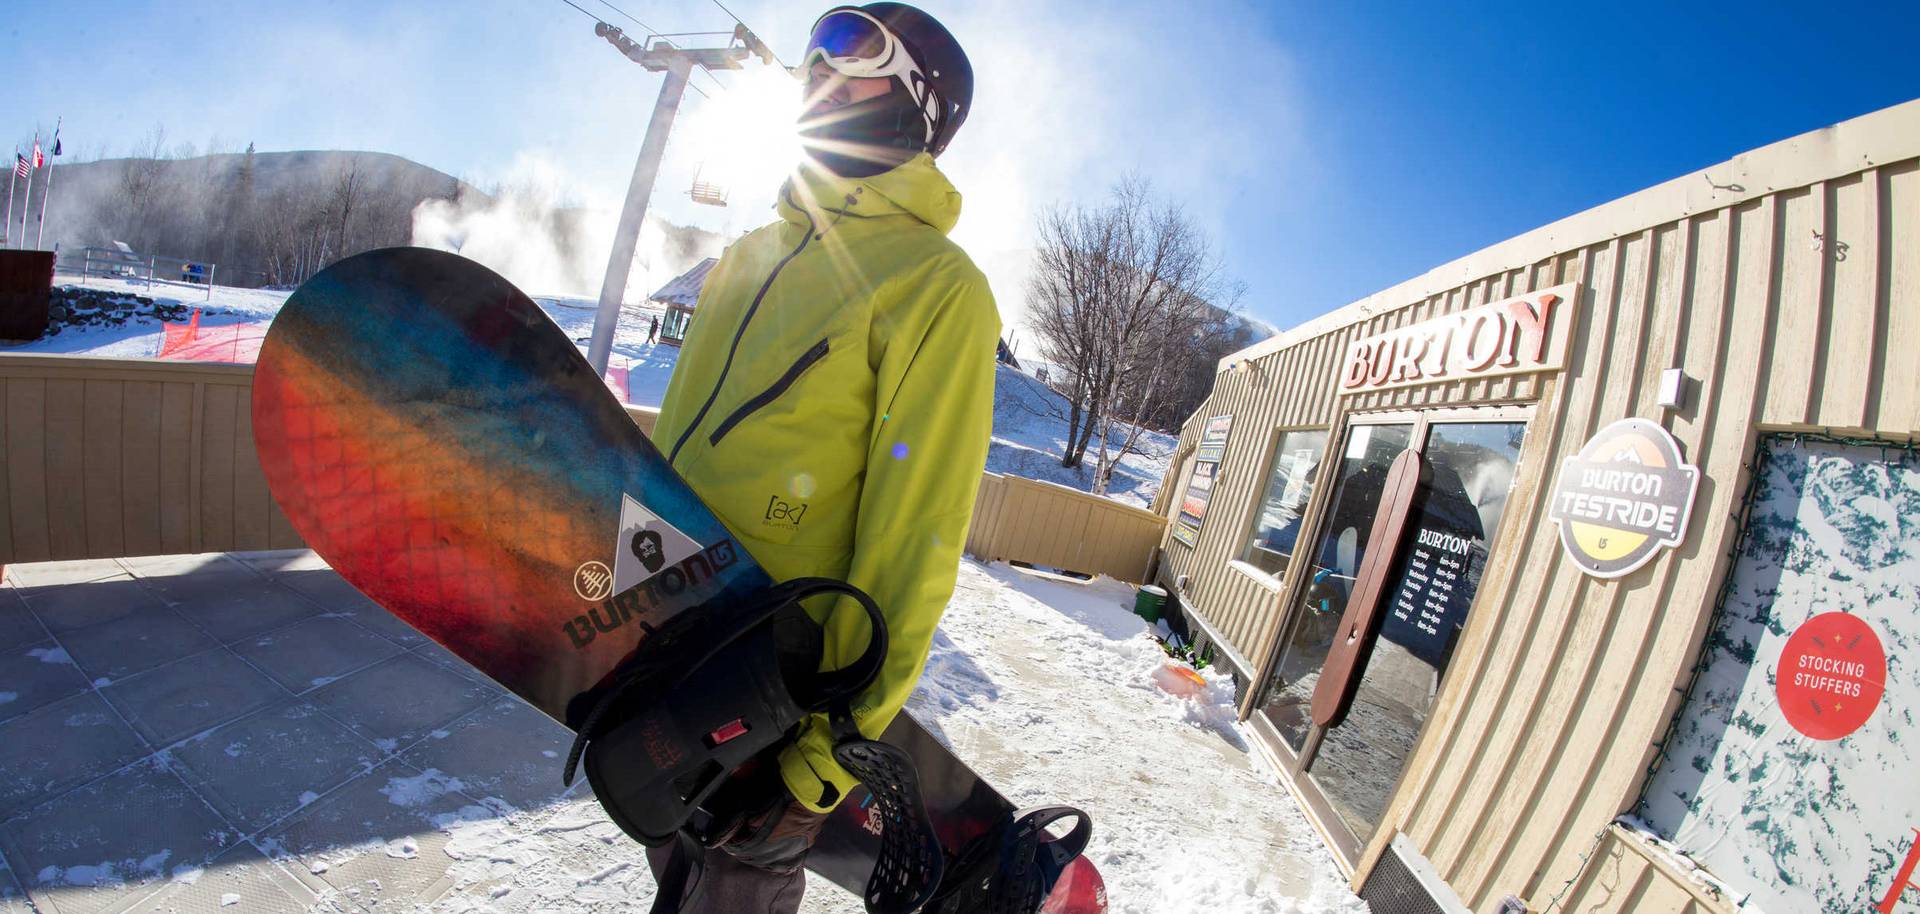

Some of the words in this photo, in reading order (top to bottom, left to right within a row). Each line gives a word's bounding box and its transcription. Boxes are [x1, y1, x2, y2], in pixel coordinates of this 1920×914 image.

[1343, 294, 1560, 388] BURTON
[1581, 468, 1662, 497] BURTON
[1561, 491, 1679, 533] TESTRIDE
[1417, 528, 1471, 555] BURTON
[1799, 654, 1865, 678] STOCKING
[1794, 672, 1861, 697] STUFFERS
